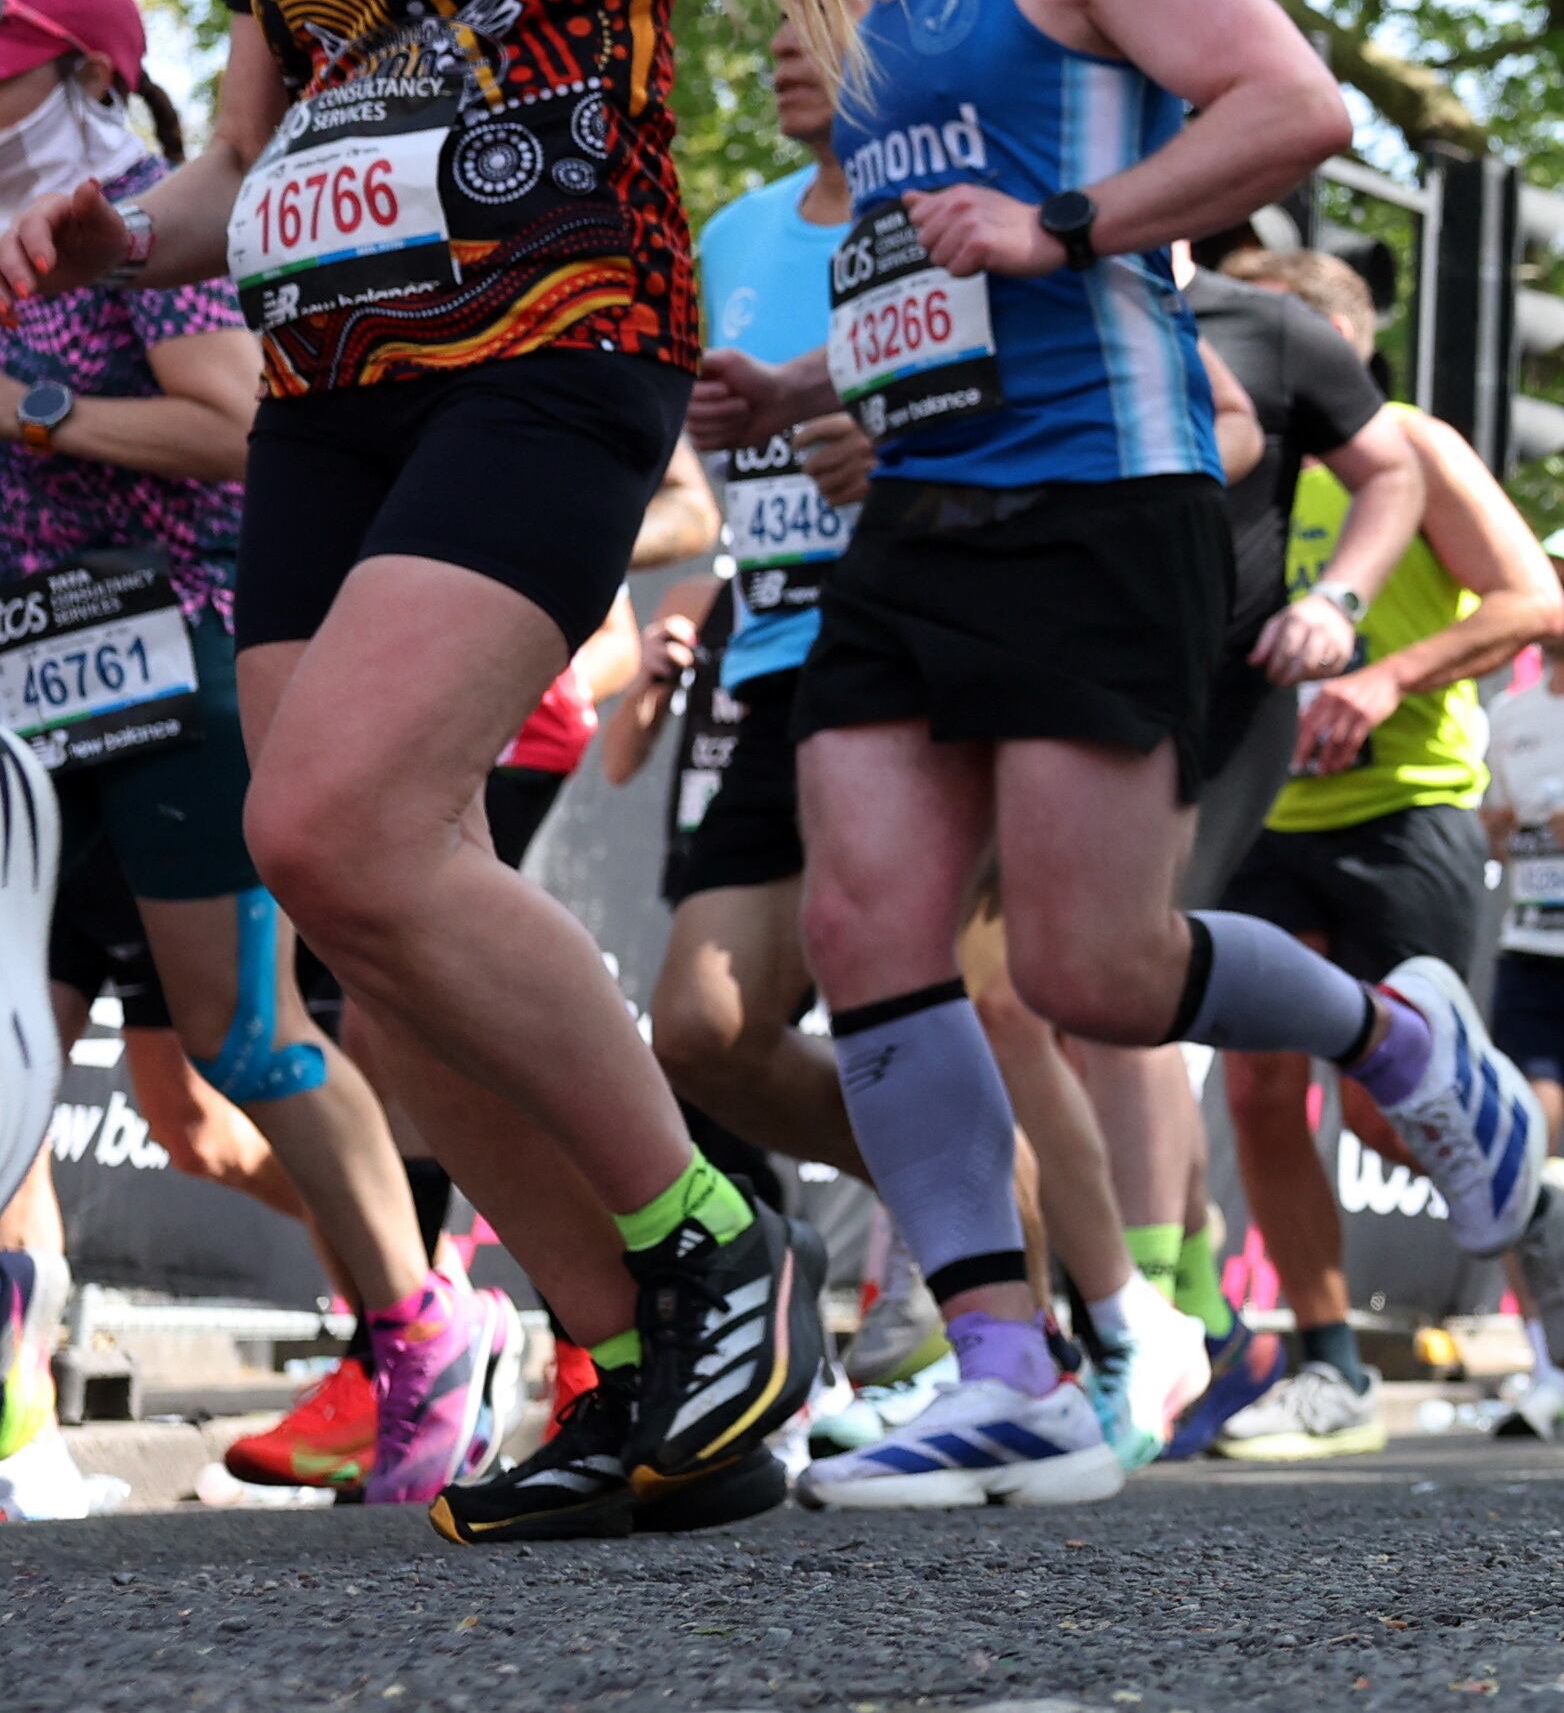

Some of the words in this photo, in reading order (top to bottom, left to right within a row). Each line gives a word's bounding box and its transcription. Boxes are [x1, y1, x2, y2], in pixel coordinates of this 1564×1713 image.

[312, 101, 387, 133] SERVICES
[318, 76, 445, 108] CONSULTANCY
[255, 158, 400, 256] 16766
[847, 290, 952, 374] 13266
[23, 636, 150, 707] 46761
